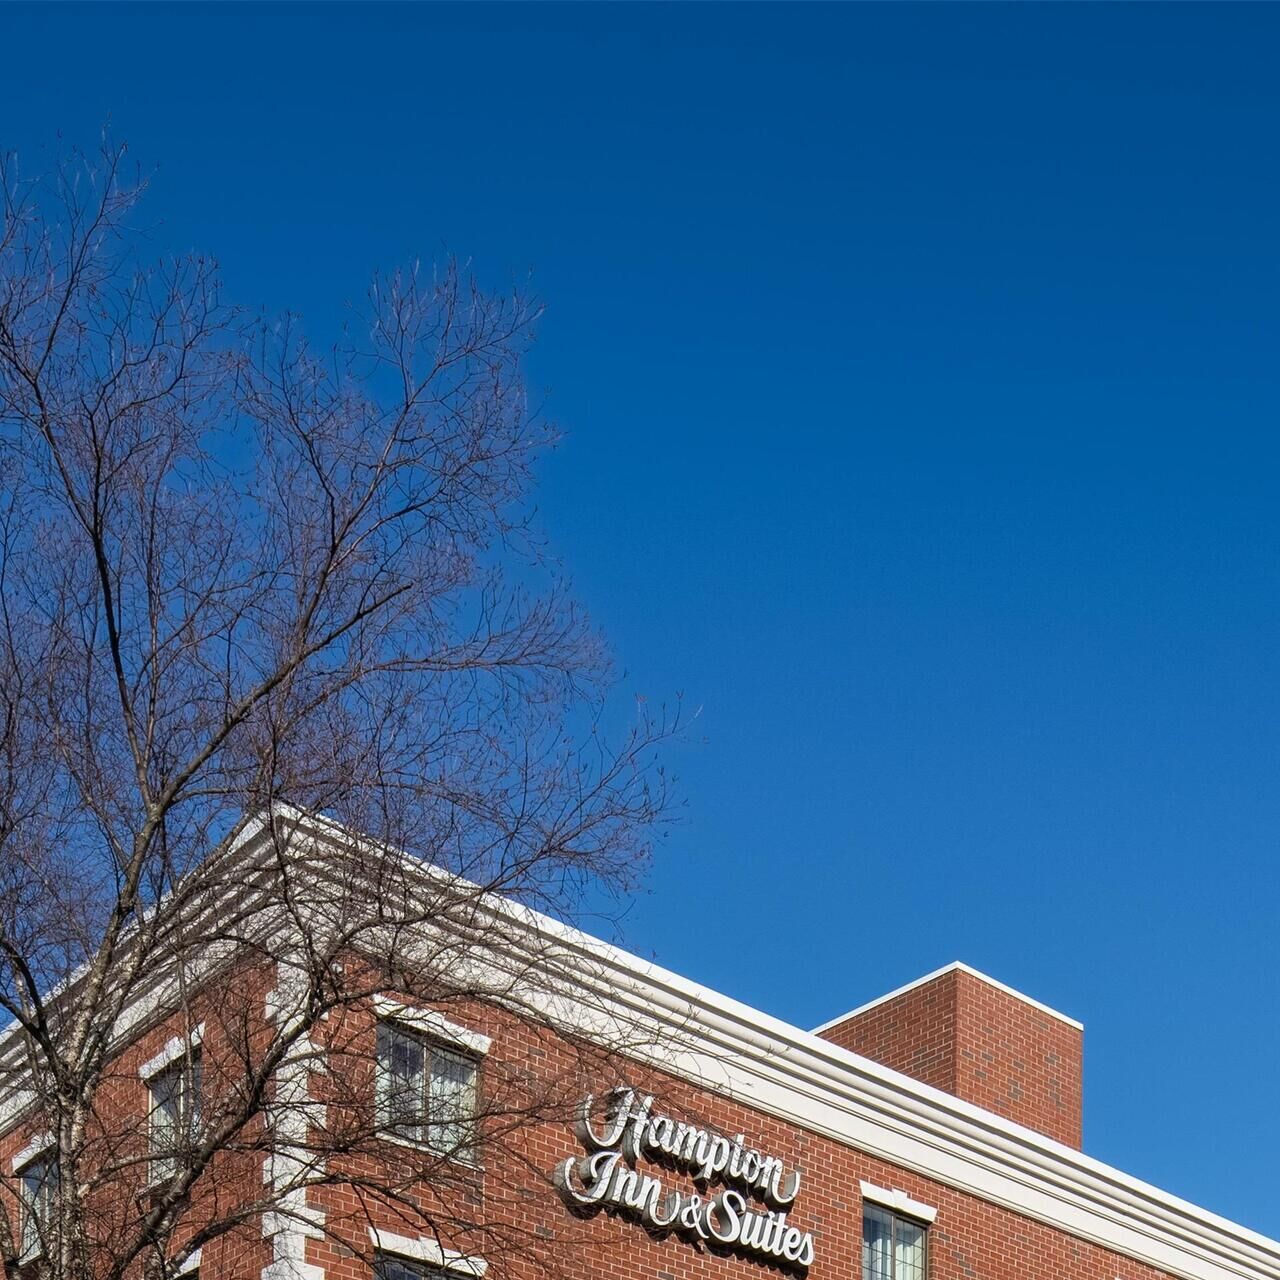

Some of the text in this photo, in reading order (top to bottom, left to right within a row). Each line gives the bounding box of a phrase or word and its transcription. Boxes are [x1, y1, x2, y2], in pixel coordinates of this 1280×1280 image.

[577, 1087, 801, 1203] Hampton
[563, 1151, 815, 1266] Inn & Suites
